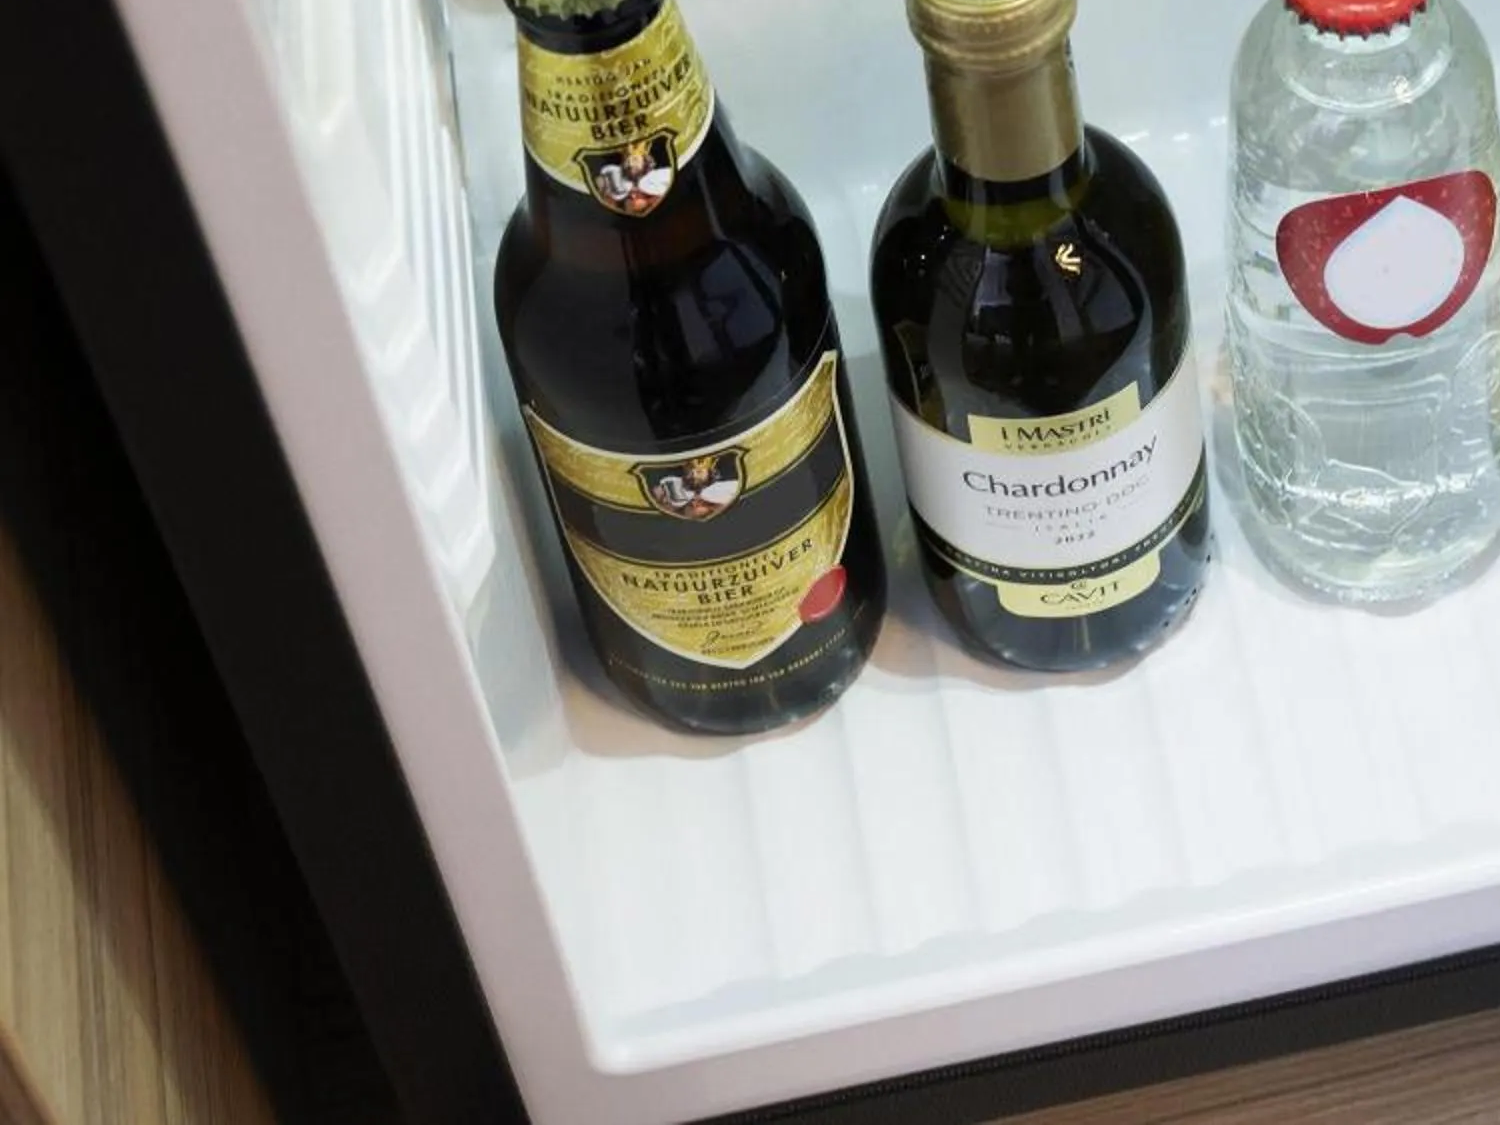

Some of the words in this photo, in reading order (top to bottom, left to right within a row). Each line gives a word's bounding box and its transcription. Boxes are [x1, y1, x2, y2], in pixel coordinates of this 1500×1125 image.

[590, 113, 650, 142] BIER
[1000, 425, 1009, 441] I
[1016, 408, 1111, 442] MASTRI
[962, 433, 1159, 499] Chardonnay
[621, 537, 813, 593] NATUURZUIVER
[697, 585, 755, 605] BIER
[1040, 579, 1121, 606] CAVIT
